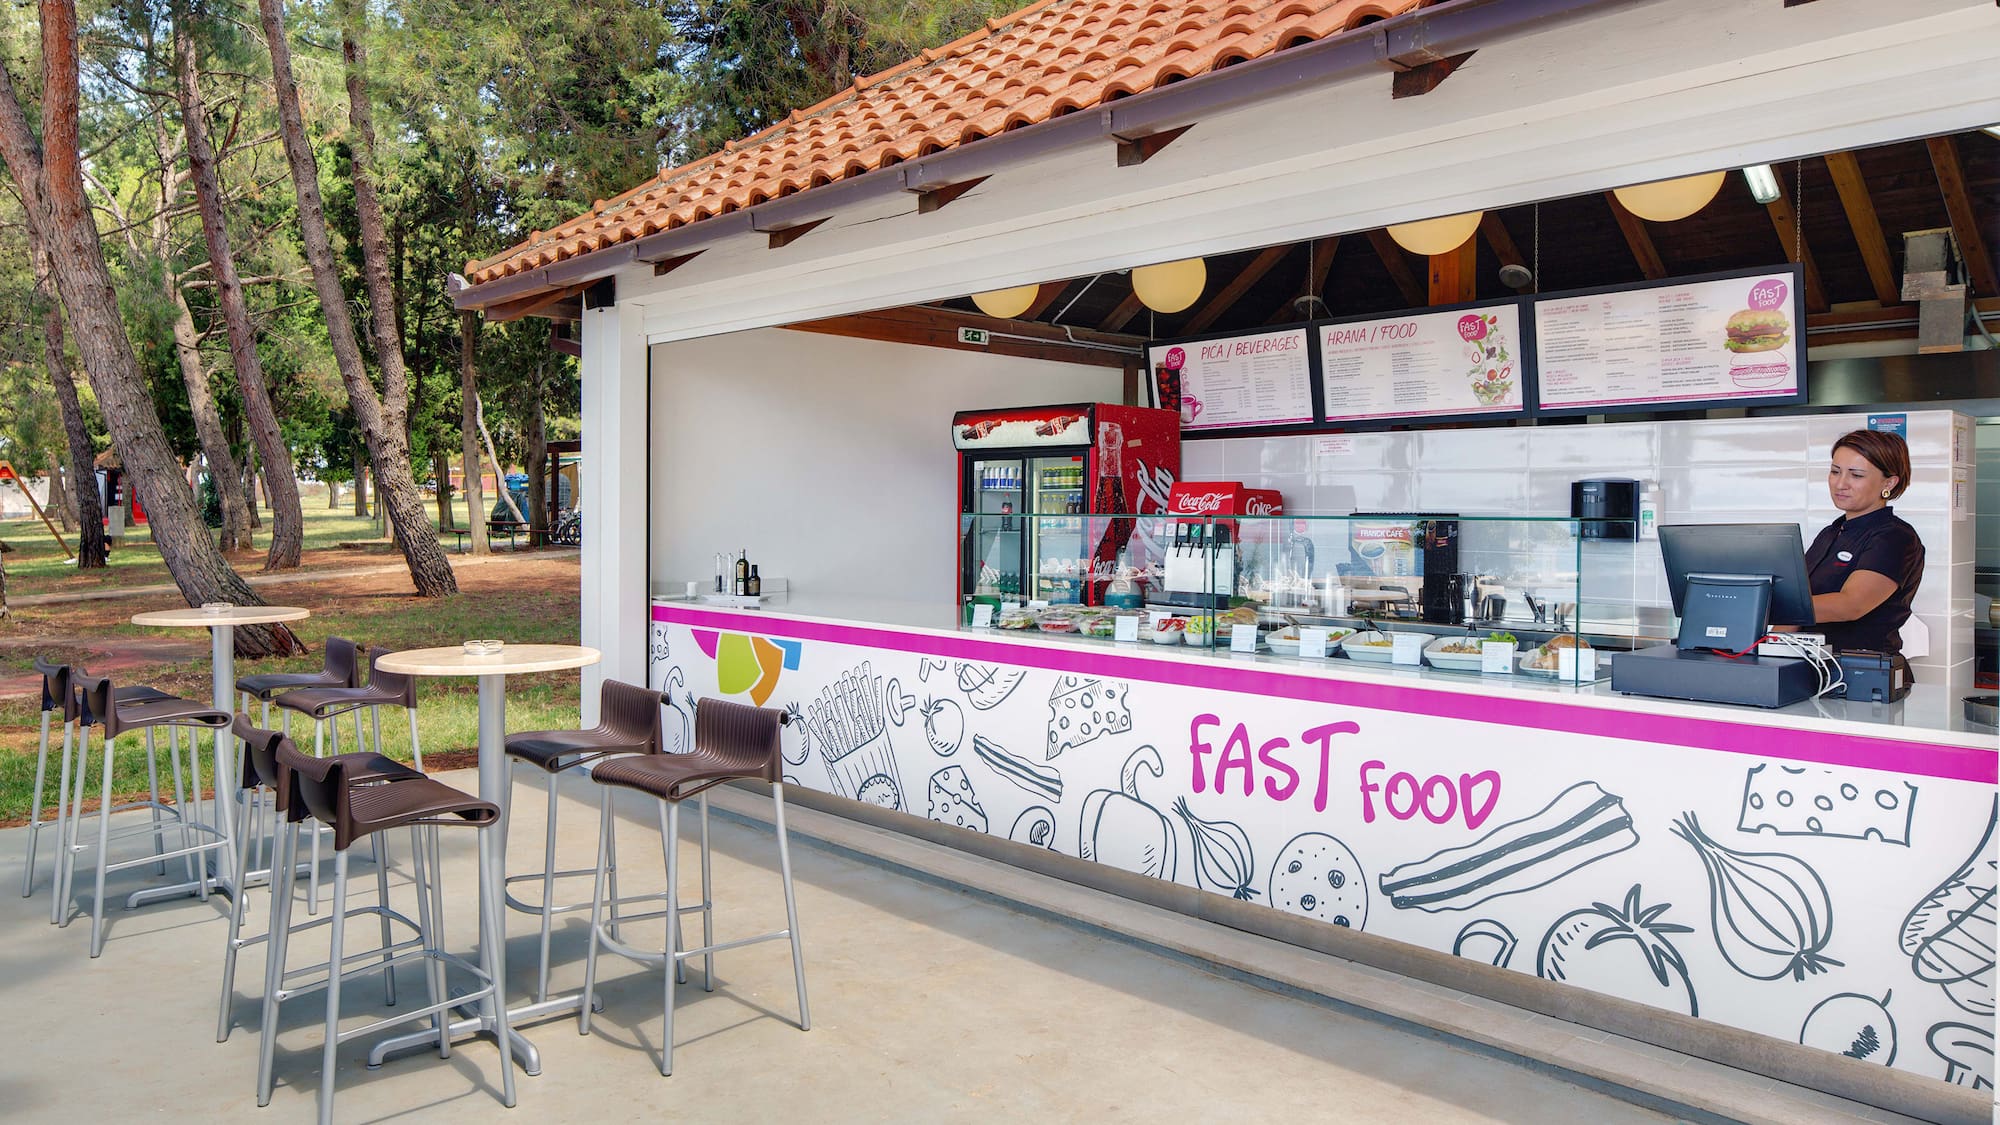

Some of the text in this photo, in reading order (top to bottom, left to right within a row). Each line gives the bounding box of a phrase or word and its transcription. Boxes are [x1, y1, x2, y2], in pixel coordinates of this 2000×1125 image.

[1754, 284, 1786, 301] FAST
[1758, 297, 1778, 309] FOOD
[1327, 327, 1366, 346] HRANA
[1381, 322, 1418, 340] FOOD
[1459, 319, 1482, 333] FAST
[1463, 329, 1479, 338] FOOD
[1235, 335, 1300, 356] BEVERAGES
[1167, 350, 1184, 363] FAST
[1178, 492, 1222, 511] Coca-Cola
[1246, 496, 1272, 516] Coke
[1360, 528, 1404, 538] FRANCK CAFÉ
[1190, 712, 1502, 831] FAST FOOD
